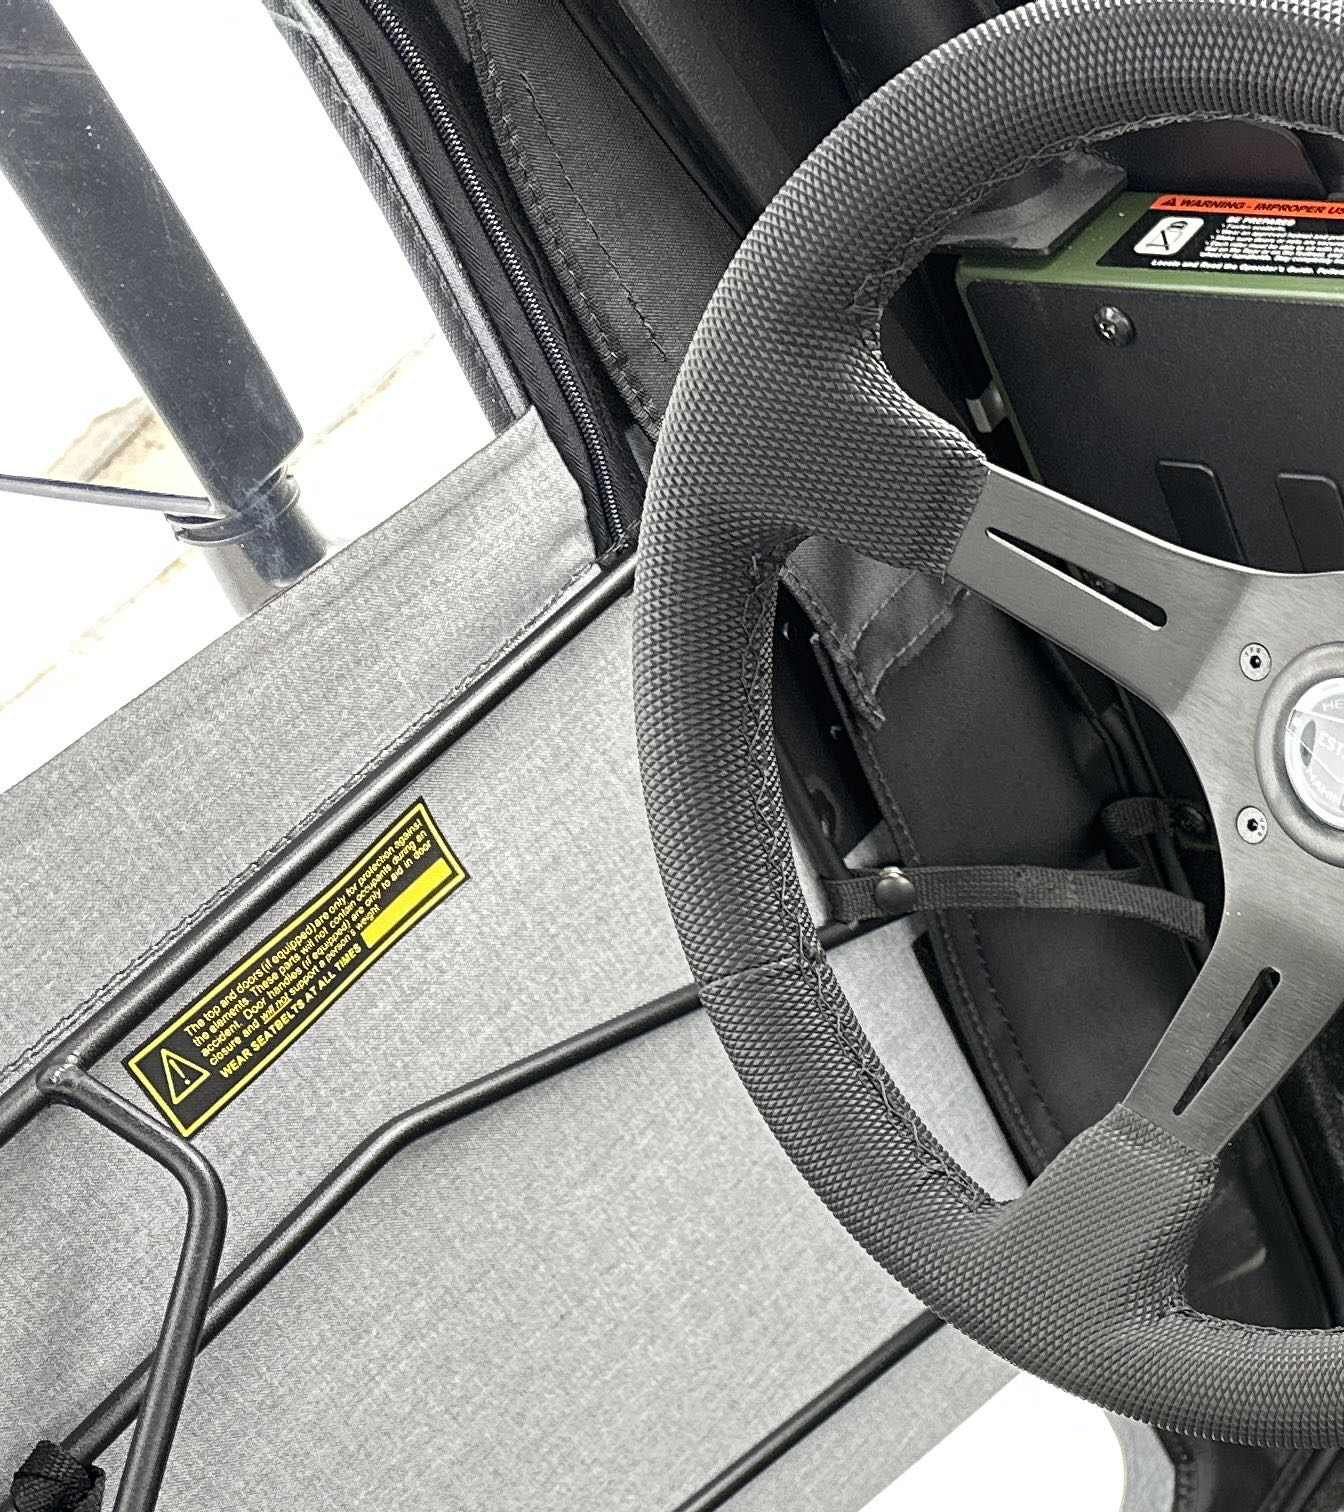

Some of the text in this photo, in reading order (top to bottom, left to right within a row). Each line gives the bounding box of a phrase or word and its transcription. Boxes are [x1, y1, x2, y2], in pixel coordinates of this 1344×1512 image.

[1179, 198, 1246, 210] WARNING
[184, 1019, 205, 1036] The
[203, 1006, 220, 1021] top
[220, 990, 237, 1008] and
[237, 969, 263, 993] doors
[314, 912, 329, 927] are
[329, 895, 346, 914] only
[346, 883, 357, 897] for
[358, 847, 395, 886] protection
[394, 819, 422, 848] against
[193, 1032, 209, 1046] the
[250, 972, 278, 996] These
[279, 954, 300, 976] parts
[300, 938, 314, 954] will
[314, 927, 328, 942] not
[327, 900, 356, 928] contain
[353, 864, 391, 901] occupants
[392, 841, 416, 864] during
[416, 830, 427, 842] an
[202, 1021, 242, 1056] accident.
[243, 998, 266, 1019] Door
[267, 967, 302, 999] handles
[352, 906, 364, 921] are
[365, 888, 380, 906] only
[381, 880, 390, 889] to
[391, 865, 403, 881] aid
[403, 858, 413, 868] in
[413, 840, 431, 859] door
[210, 1037, 241, 1065] closure
[242, 1019, 260, 1037] and
[260, 1004, 275, 1021] will
[275, 992, 289, 1008] not
[289, 966, 319, 995] support
[319, 960, 326, 968] a
[220, 944, 361, 1077] WEAR SEATBELTS AT ALL TIMES
